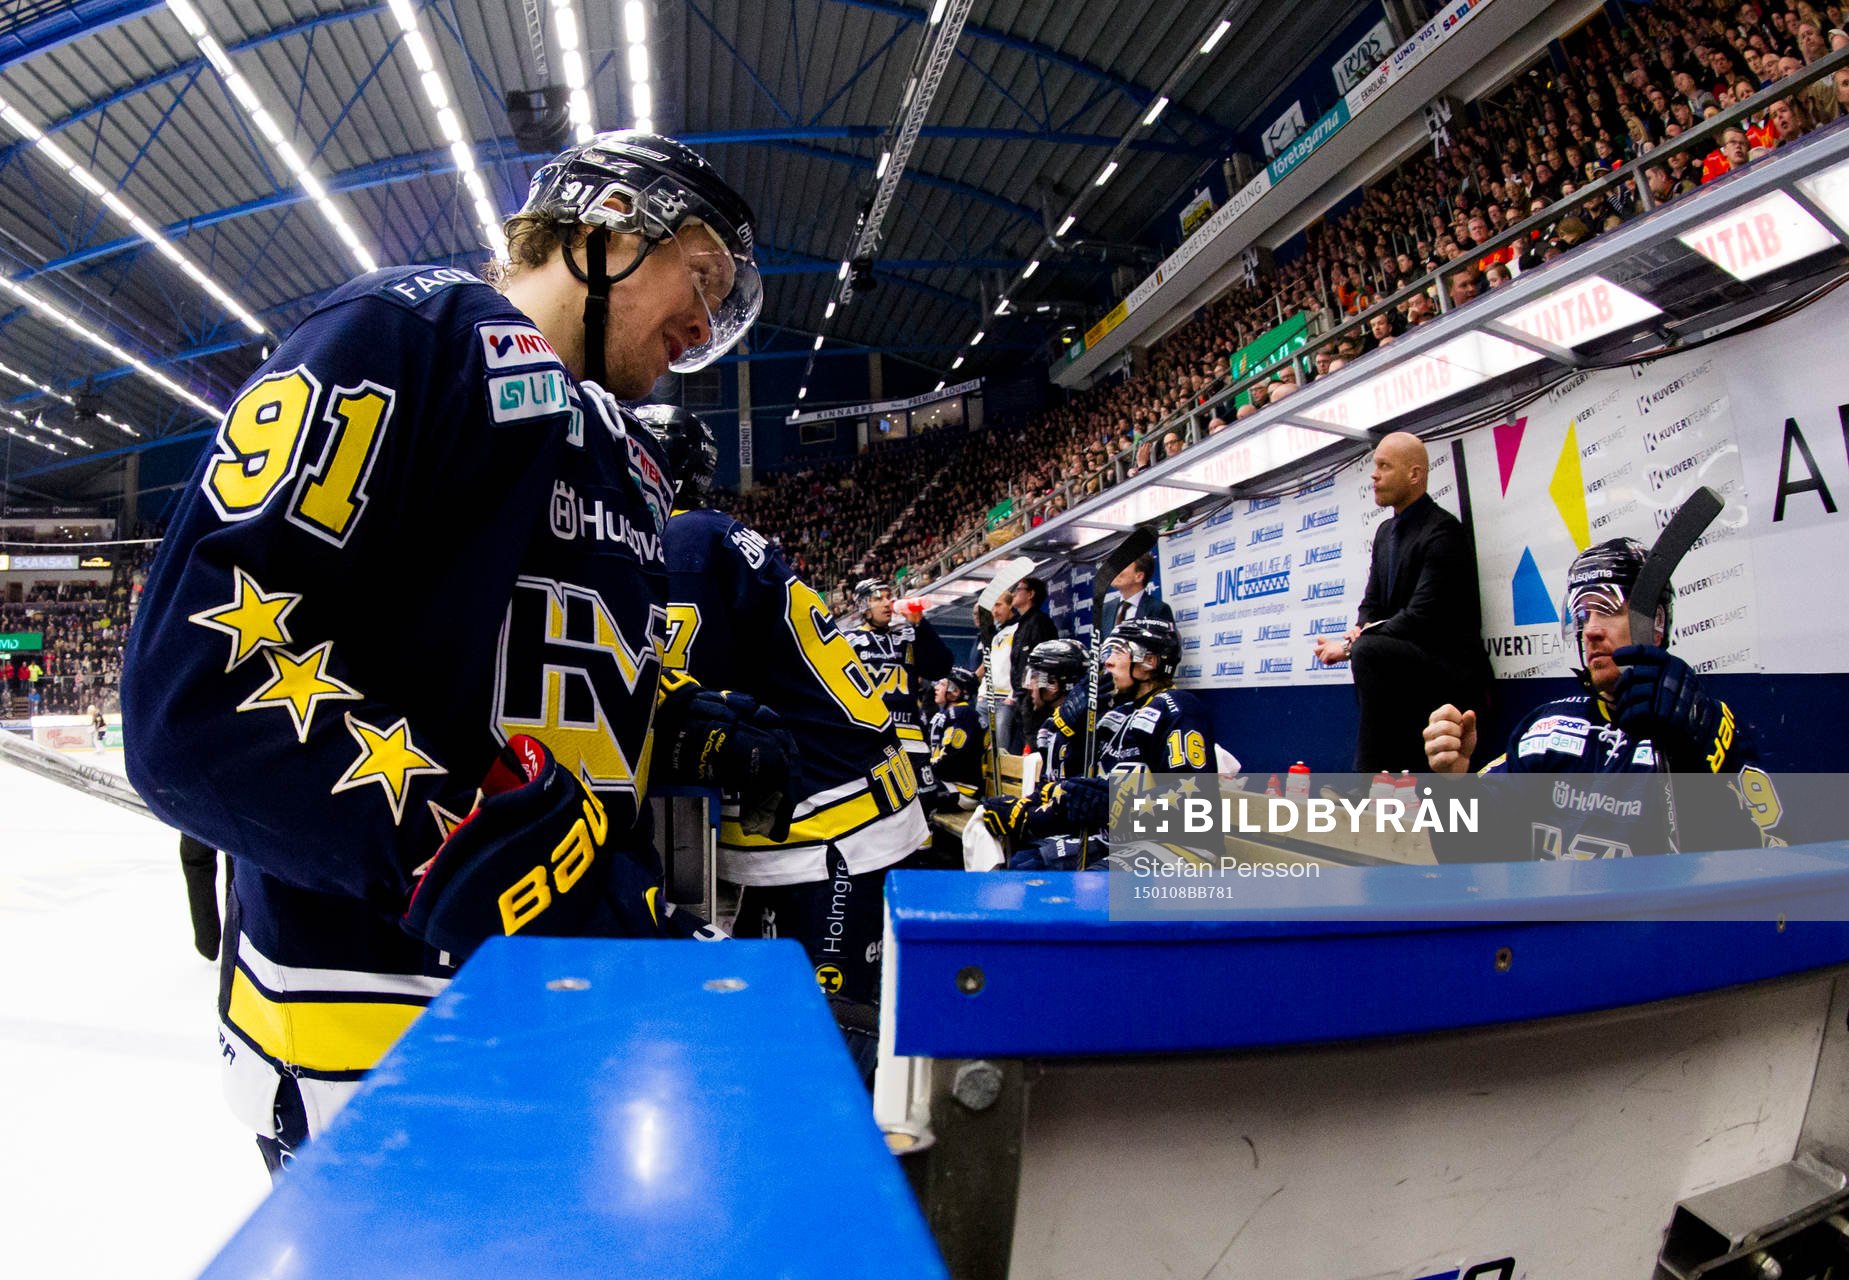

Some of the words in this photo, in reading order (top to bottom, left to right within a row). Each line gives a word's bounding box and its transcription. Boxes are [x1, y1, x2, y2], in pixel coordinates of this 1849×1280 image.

[1272, 110, 1340, 178] företagarna
[561, 180, 594, 204] 91
[816, 405, 875, 419] KINNARPS
[945, 378, 979, 397] LOUNGE
[200, 362, 396, 550] 91
[14, 556, 73, 568] SKANSKA
[1204, 566, 1244, 608] JUNE
[1087, 628, 1101, 711] SUPREME
[1167, 729, 1207, 769] 16
[823, 860, 852, 953] Holmgre
